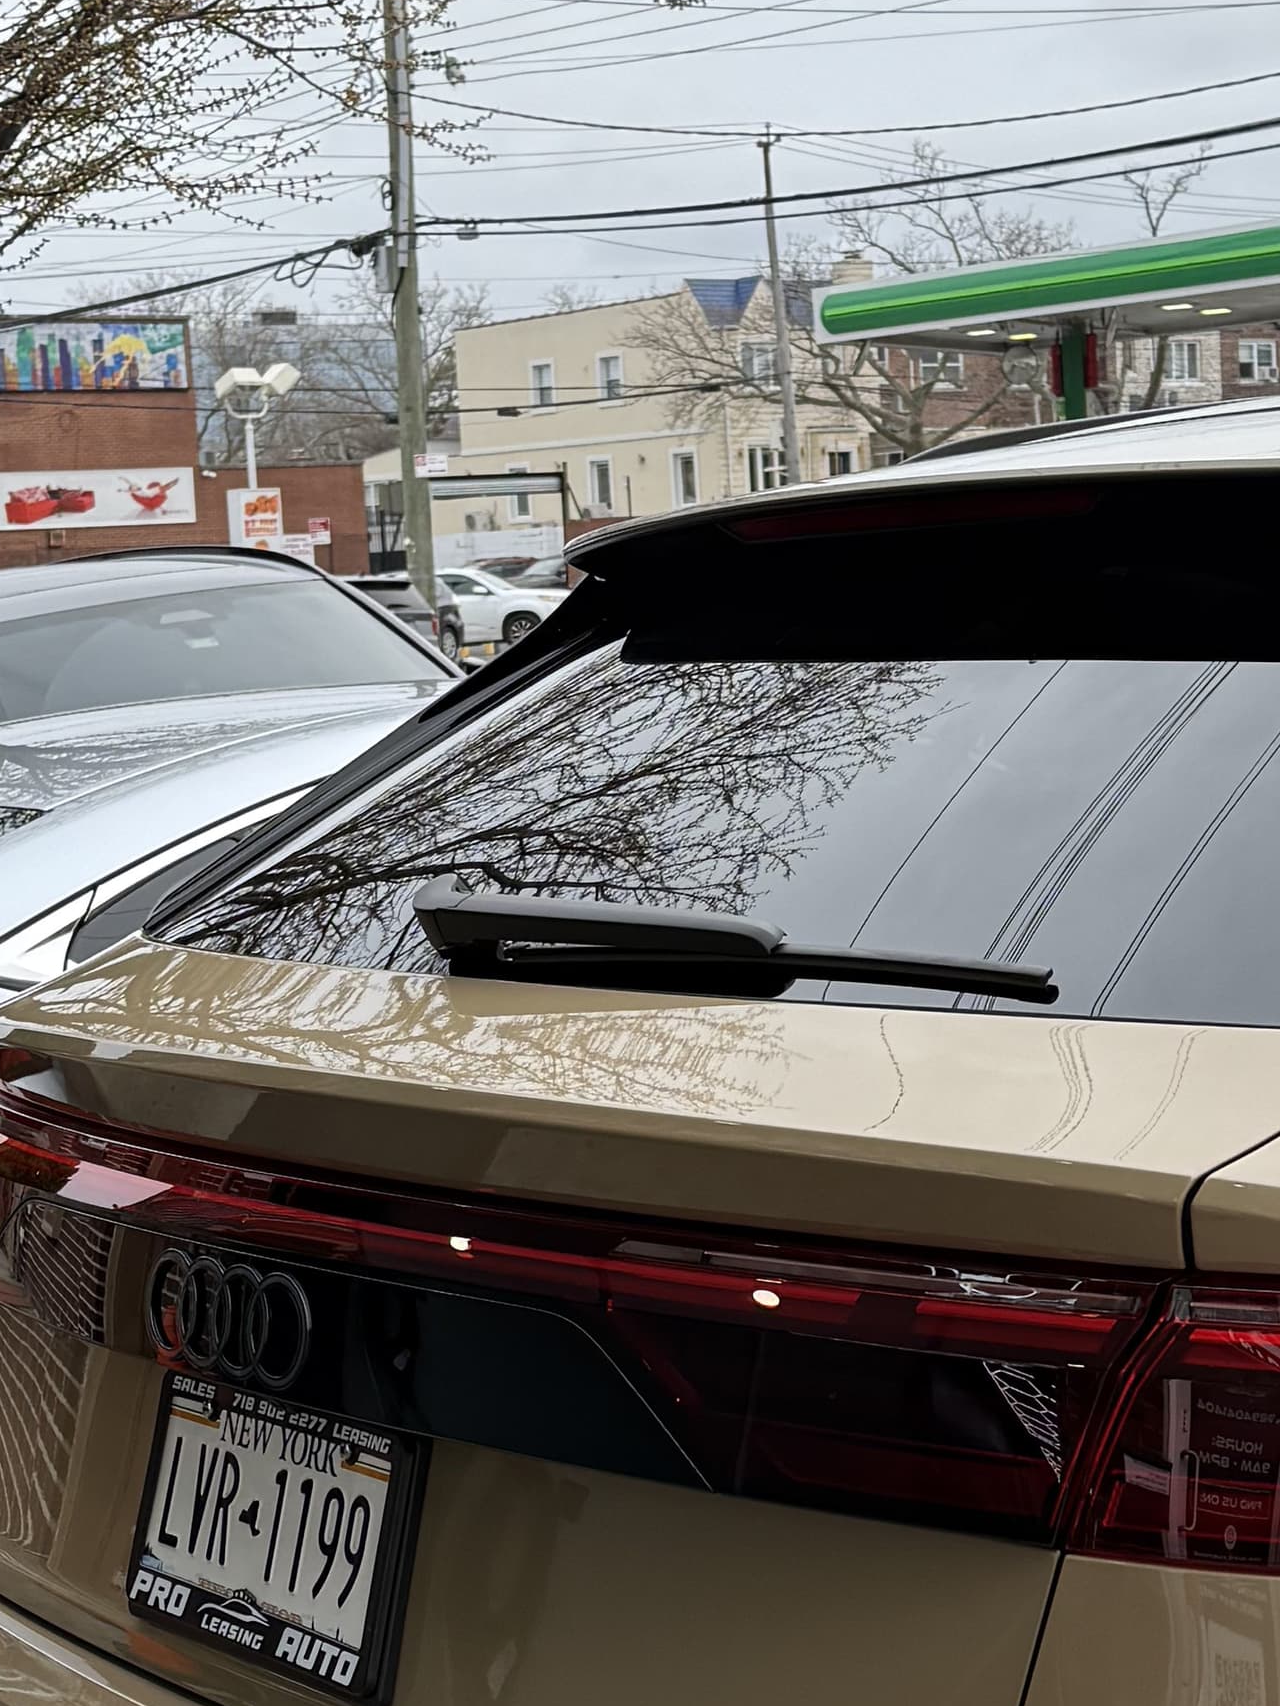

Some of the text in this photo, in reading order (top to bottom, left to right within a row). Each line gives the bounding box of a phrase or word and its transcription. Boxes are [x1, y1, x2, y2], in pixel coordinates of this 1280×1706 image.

[172, 1375, 392, 1454] SALES 718 902 2277 LEASING
[220, 1409, 339, 1477] NEW YORK
[158, 1436, 371, 1609] LVR 1199
[129, 1569, 191, 1618] PRO
[275, 1627, 360, 1687] AUTO
[200, 1613, 264, 1650] LEASING
